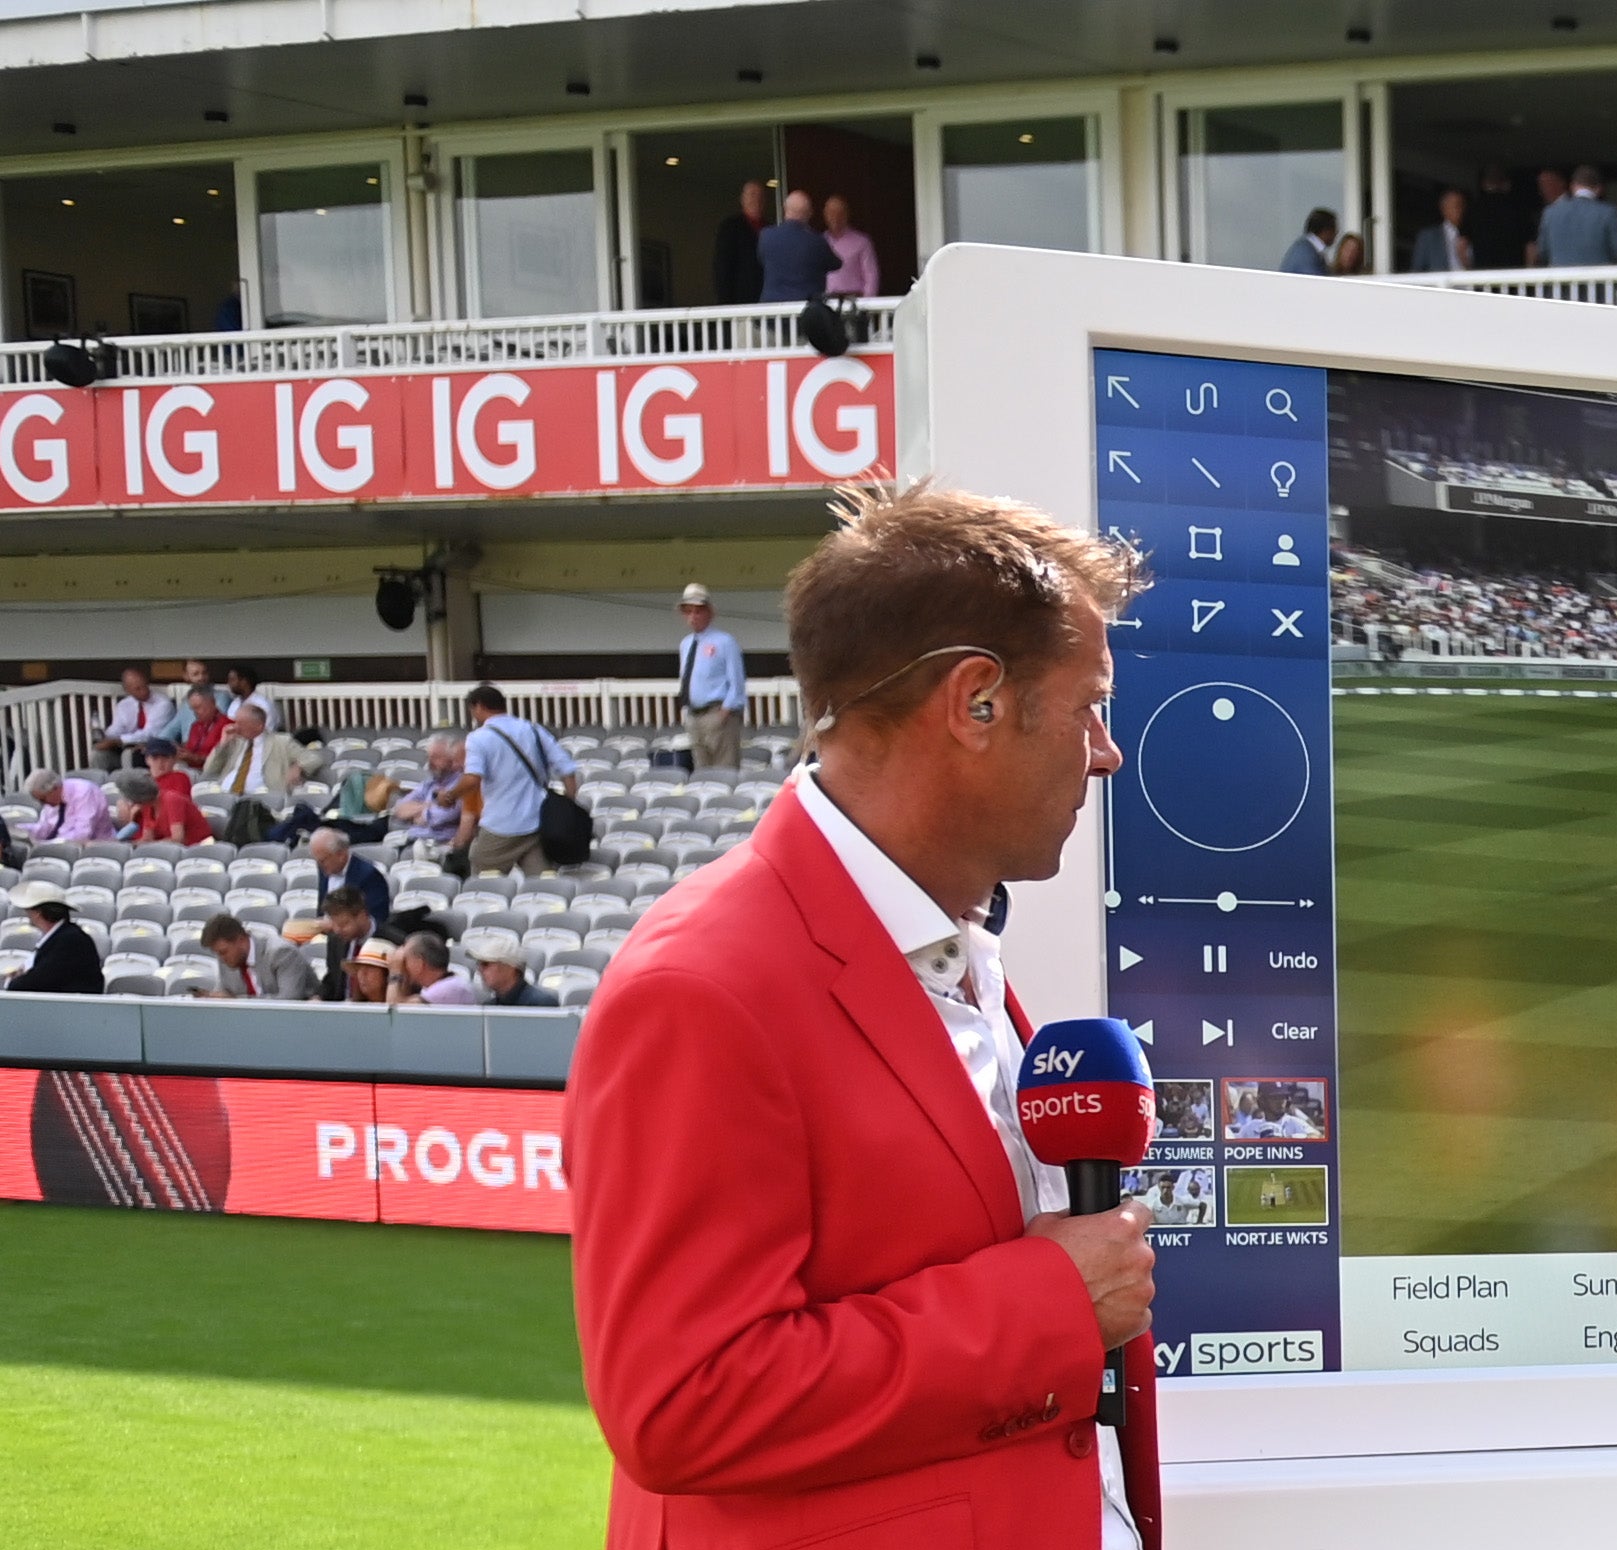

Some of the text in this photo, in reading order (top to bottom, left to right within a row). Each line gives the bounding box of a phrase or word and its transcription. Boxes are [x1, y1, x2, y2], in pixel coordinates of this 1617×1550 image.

[0, 358, 878, 503] G IG IG IG IG IG
[1269, 951, 1318, 969] Undo
[1271, 1022, 1318, 1040] Clear
[1032, 1045, 1085, 1078] sky
[1020, 1091, 1102, 1124] sports
[315, 1121, 568, 1190] PROGR
[1142, 1147, 1214, 1160] LEY SUMMER
[1225, 1146, 1304, 1160] POPE INNS
[1158, 1233, 1192, 1247] WKT
[1226, 1231, 1328, 1246] NORTJE WKTS
[1393, 1274, 1509, 1300] Field Plan
[1198, 1337, 1315, 1371] sports
[1403, 1328, 1500, 1359] Squads
